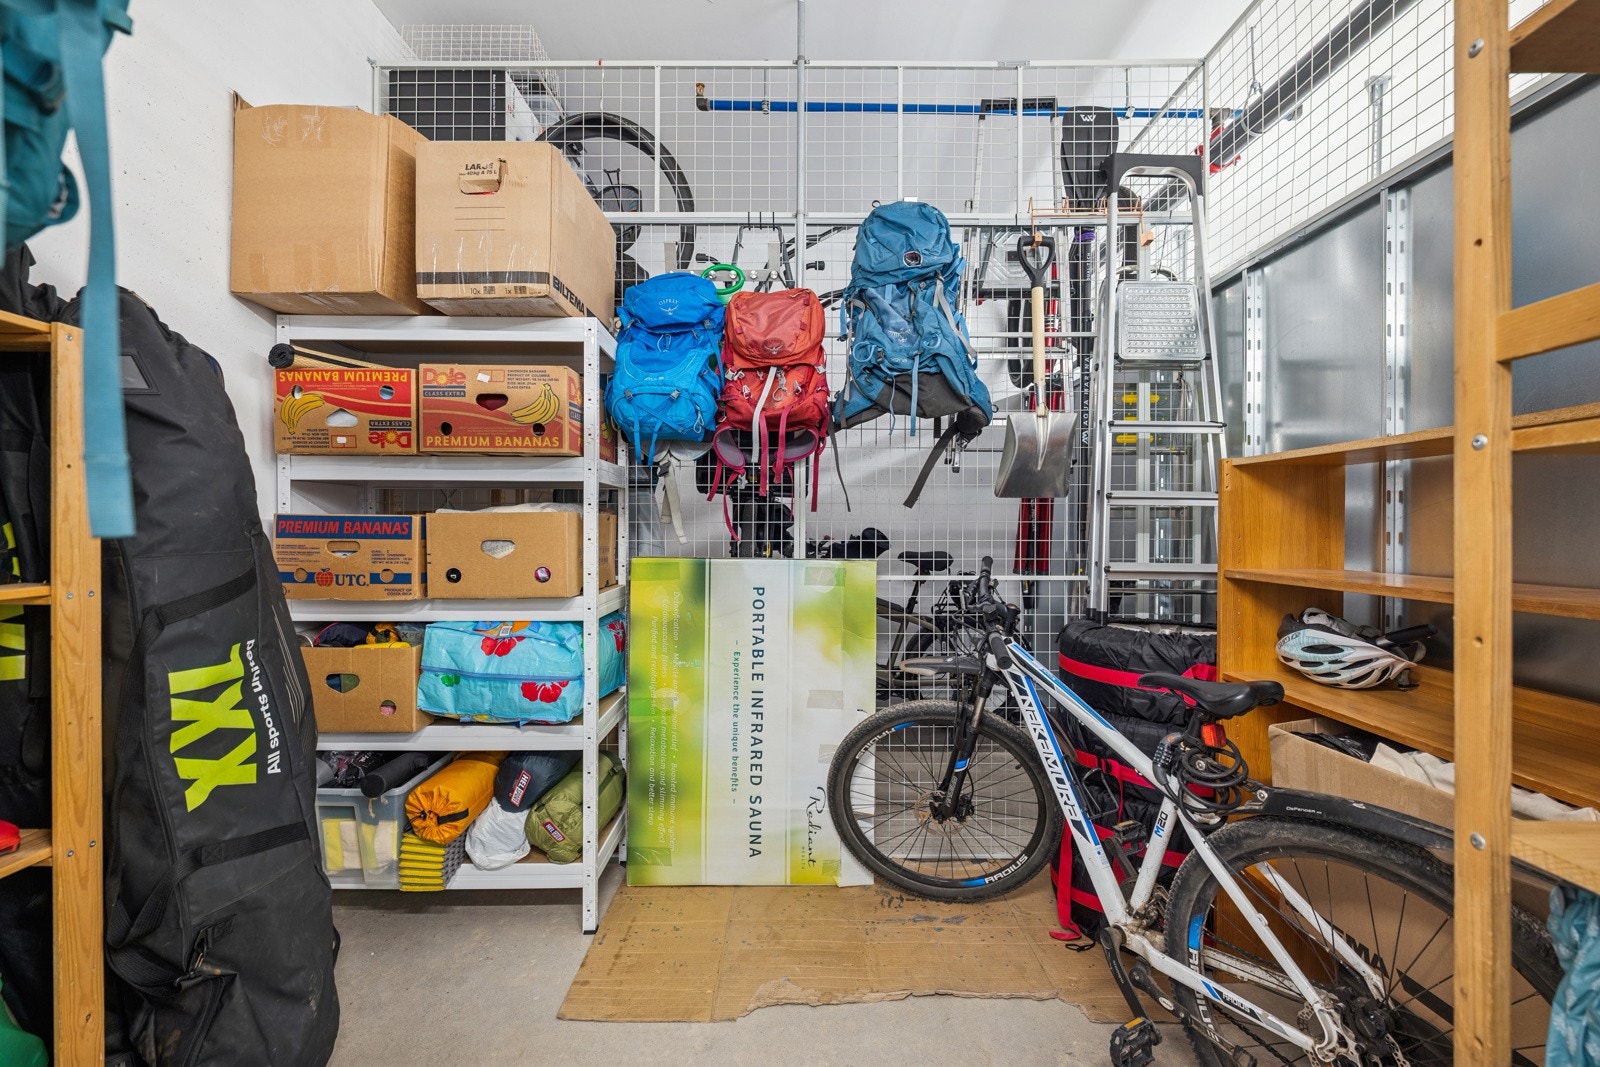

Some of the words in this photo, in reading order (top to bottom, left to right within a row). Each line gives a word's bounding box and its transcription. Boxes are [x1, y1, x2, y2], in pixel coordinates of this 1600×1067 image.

[552, 275, 585, 316] BILTEMA
[658, 298, 679, 306] OSPREY
[279, 371, 339, 382] BANANAS
[344, 371, 408, 382] PREMIUM
[422, 368, 467, 386] Dole
[368, 430, 412, 448] Dole
[426, 436, 490, 446] PREMIUM
[495, 436, 559, 446] BANANAS
[278, 520, 340, 534] PREMIUM
[343, 521, 410, 535] BANANAS
[650, 616, 658, 643] Purified
[672, 591, 680, 641] Detoxification
[751, 586, 766, 682] PORTABLE
[650, 645, 658, 658] and
[731, 651, 741, 700] Experience
[258, 694, 280, 750] sports
[732, 704, 740, 718] the
[168, 642, 257, 812] XXL
[730, 721, 740, 752] unique
[750, 690, 764, 786] INFRARED
[670, 731, 678, 751] relief
[267, 750, 282, 774] All
[730, 755, 740, 792] benefits
[670, 762, 678, 792] Boosted
[648, 784, 656, 804] better
[658, 786, 666, 820] slimming
[658, 823, 666, 843] effect
[749, 795, 762, 859] SAUNA
[806, 786, 826, 868] Radiant
[1154, 810, 1168, 838] M20
[668, 825, 676, 851] system
[984, 854, 1028, 884] RADIUS
[1222, 993, 1250, 1012] RADIUS
